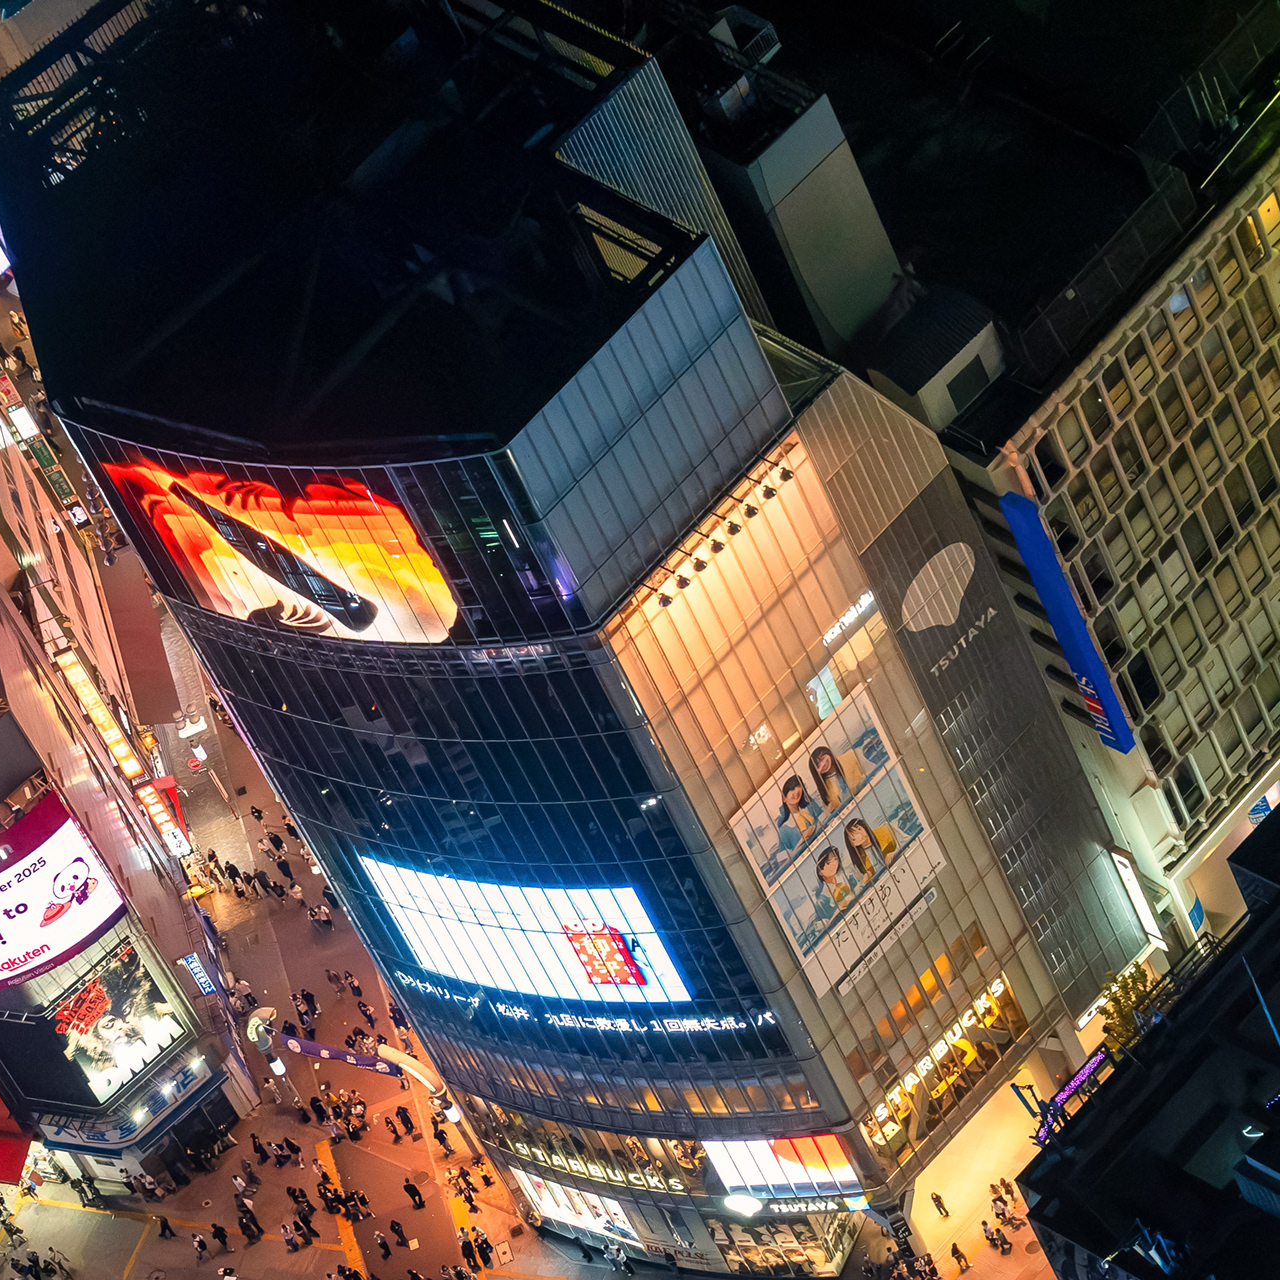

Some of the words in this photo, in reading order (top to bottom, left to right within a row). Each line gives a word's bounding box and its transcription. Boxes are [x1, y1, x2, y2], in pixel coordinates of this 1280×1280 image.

[931, 607, 999, 678] TSUTAYA
[1074, 672, 1115, 742] SEIBU
[14, 856, 47, 884] 2025
[3, 902, 28, 920] to
[832, 868, 906, 947] たすけあい
[33, 962, 56, 977] Vision
[874, 977, 1005, 1122] STARBUCKS
[516, 1143, 684, 1190] STARBUCKS
[770, 1201, 839, 1213] TSUTAYA
